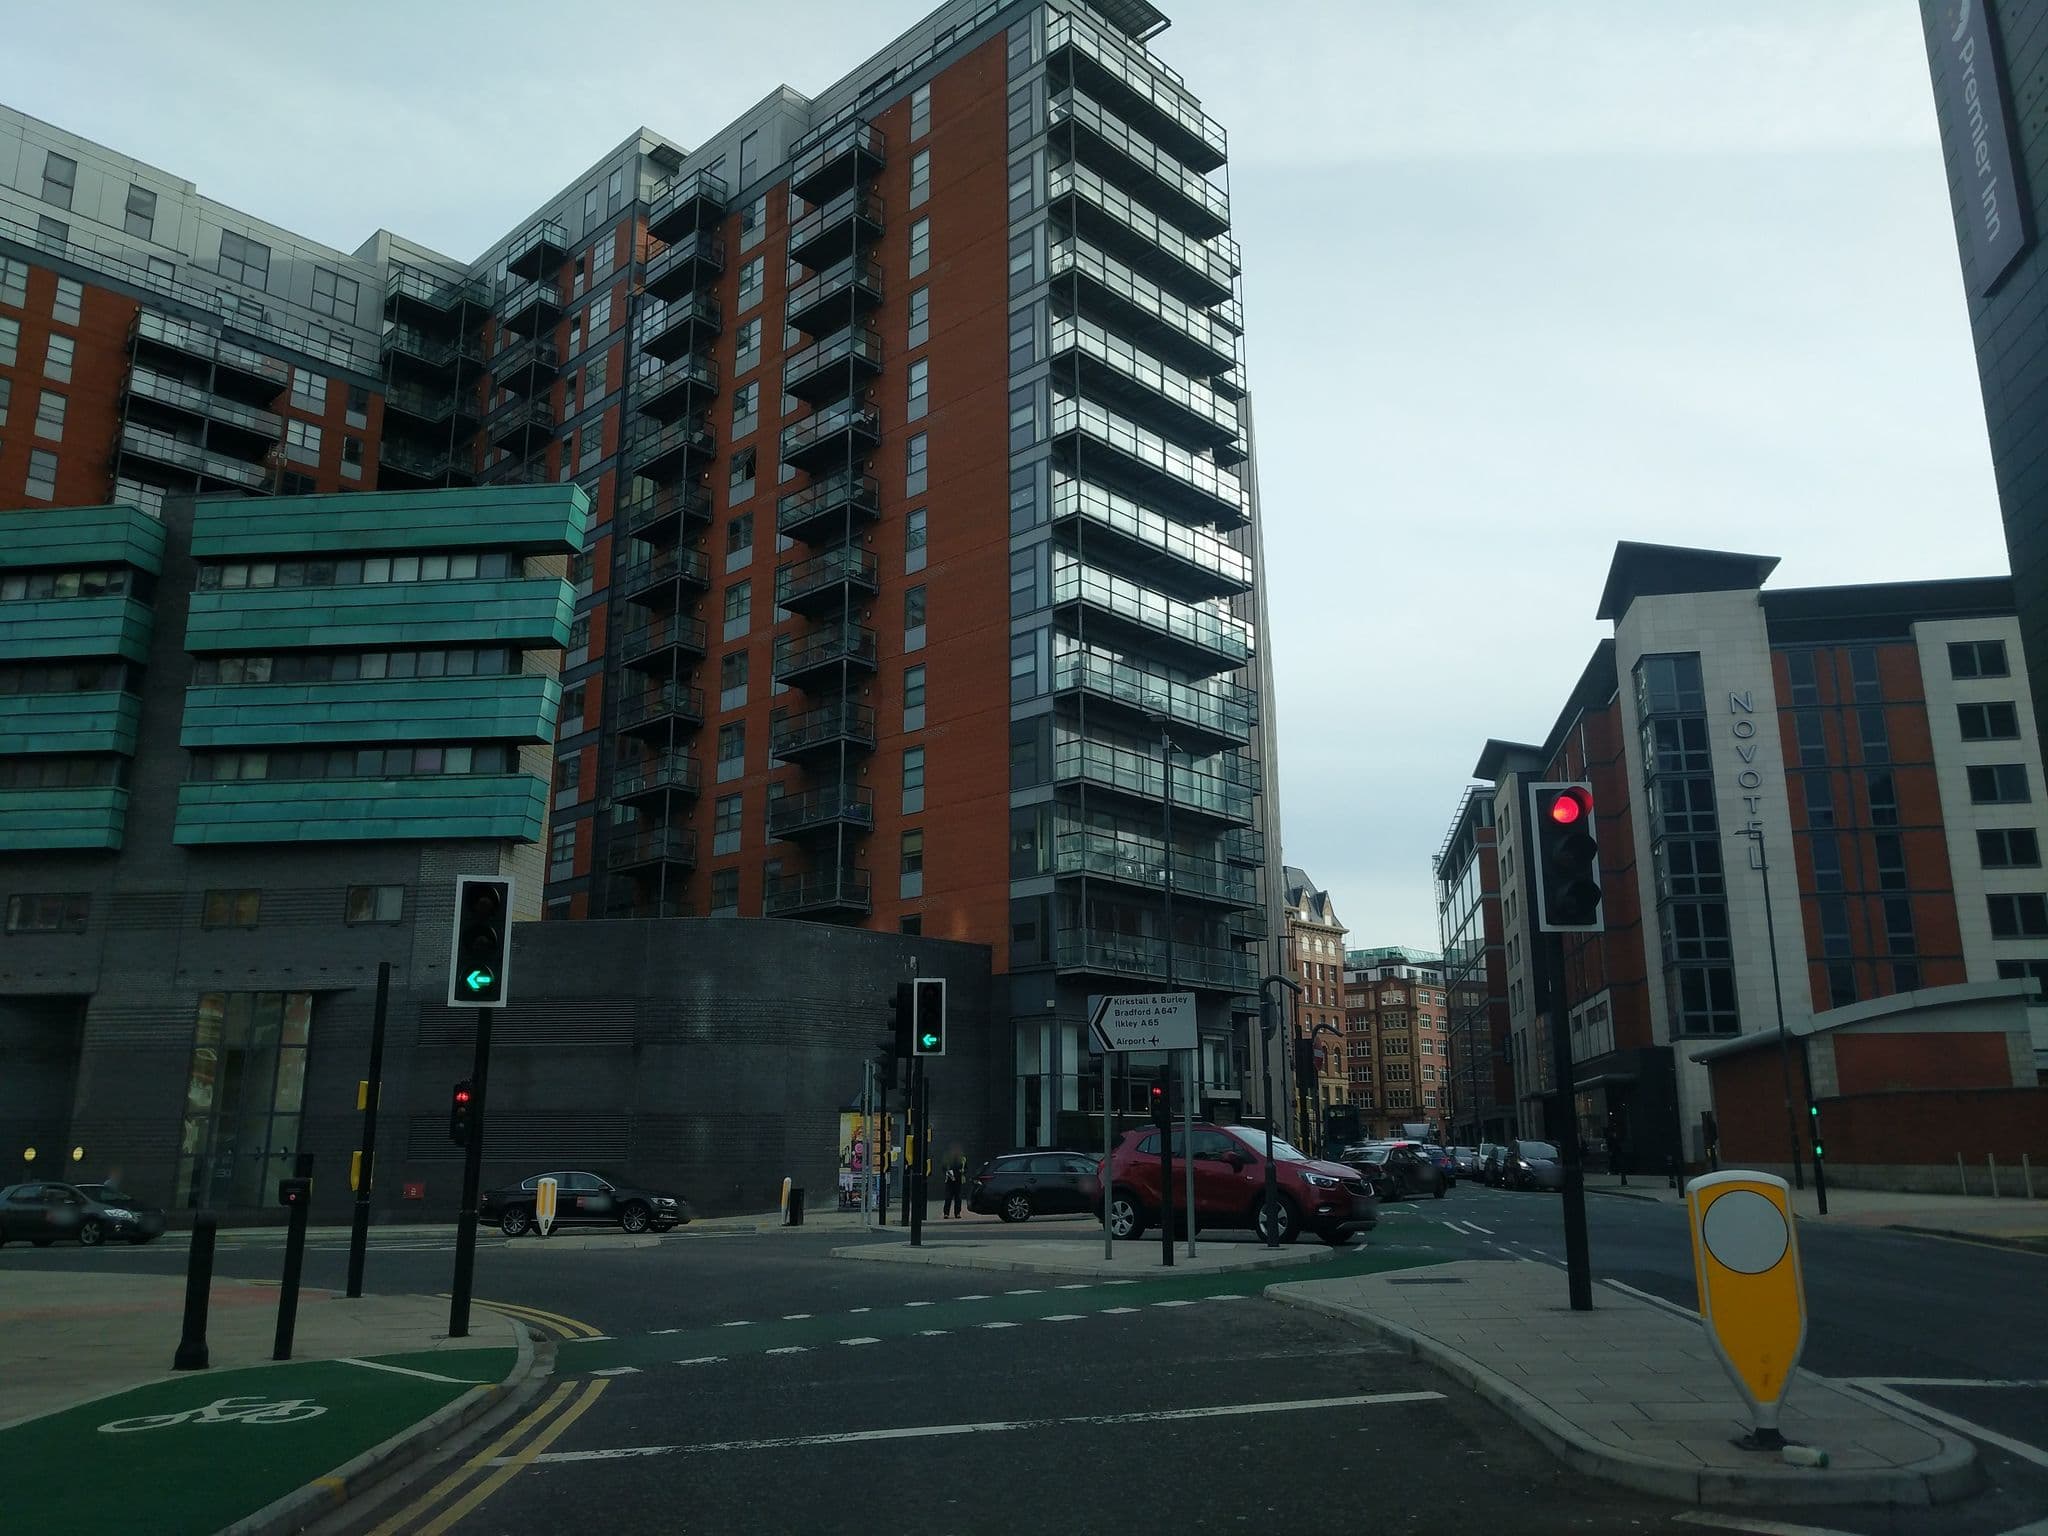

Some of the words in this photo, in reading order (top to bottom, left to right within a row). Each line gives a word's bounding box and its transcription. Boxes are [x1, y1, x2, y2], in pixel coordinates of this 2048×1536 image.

[1958, 35, 1993, 178] Premier
[1981, 176, 2002, 243] Inn
[1728, 690, 1769, 870] NOVOTEL
[1114, 998, 1149, 1006] Kirkstall
[1160, 996, 1188, 1005] Burley
[1114, 1008, 1151, 1017] Bradford
[1115, 1019, 1138, 1028] Ilkley
[1141, 1018, 1159, 1027] A65
[1116, 1036, 1146, 1046] Airport
